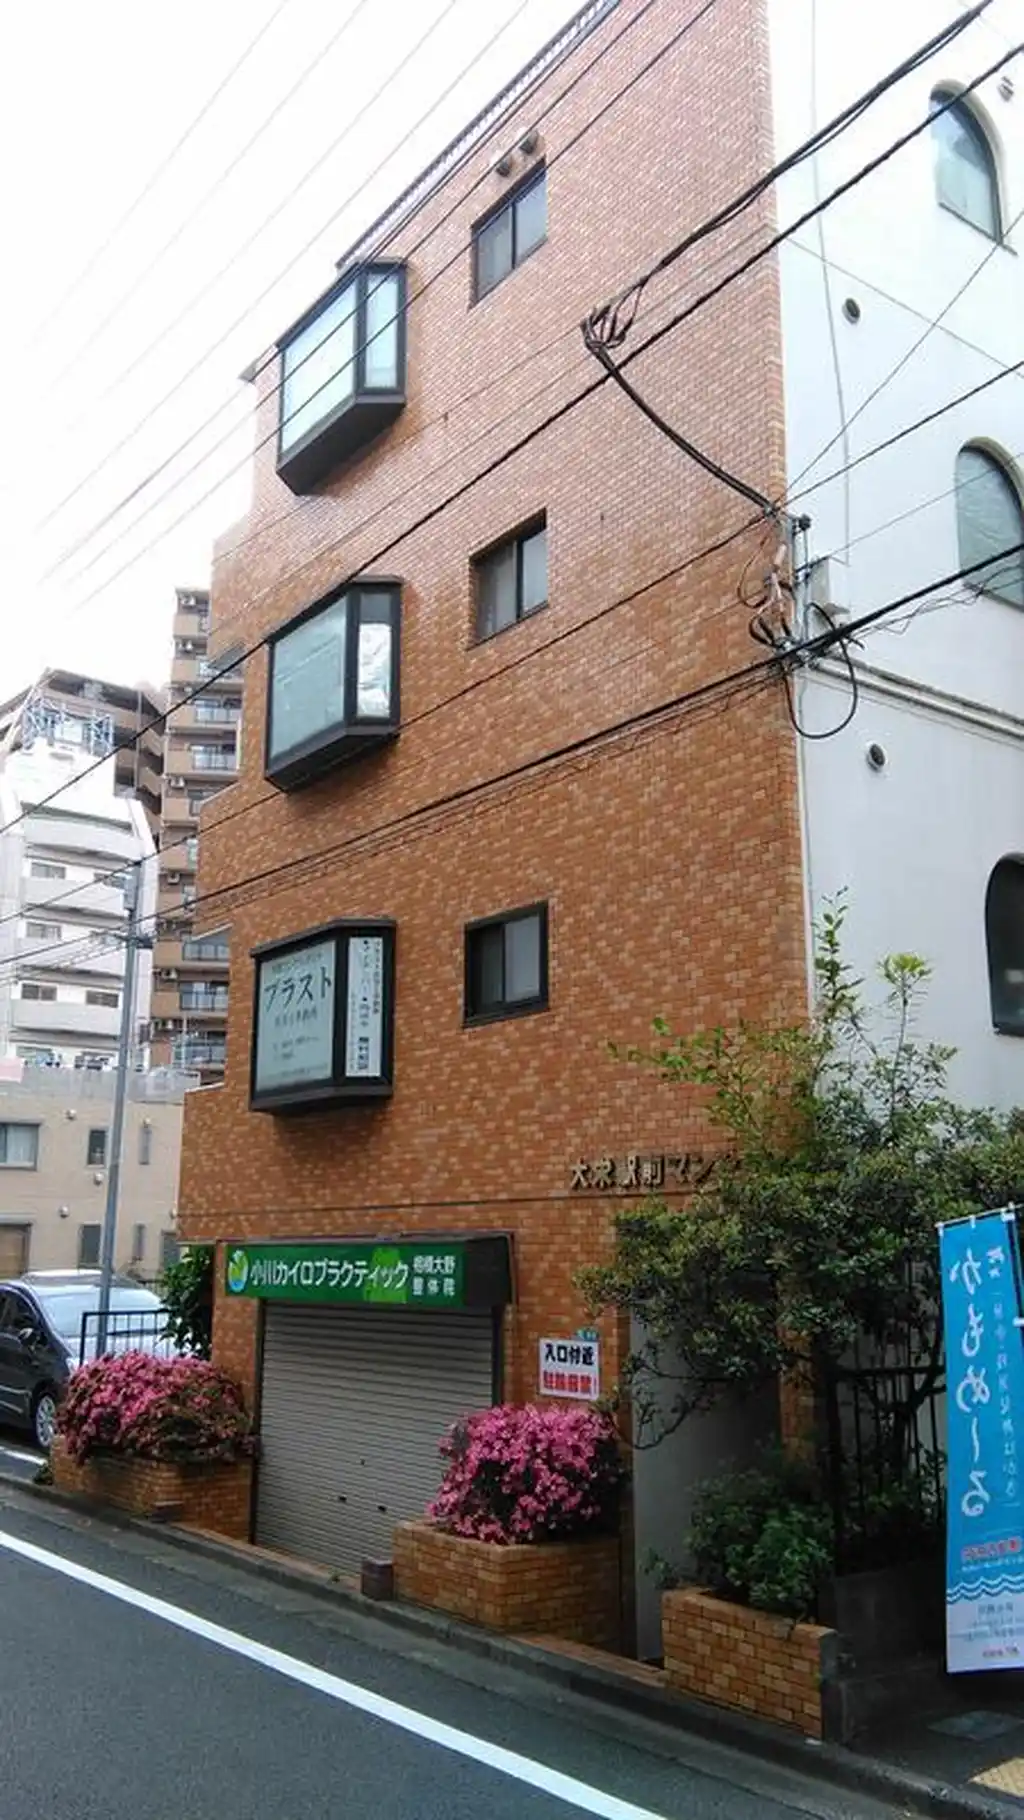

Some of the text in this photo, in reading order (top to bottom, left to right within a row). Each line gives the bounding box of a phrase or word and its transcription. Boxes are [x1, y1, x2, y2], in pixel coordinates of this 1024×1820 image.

[250, 1257, 408, 1289] 小川カイロプラクティック
[545, 1343, 594, 1366] 入口付近
